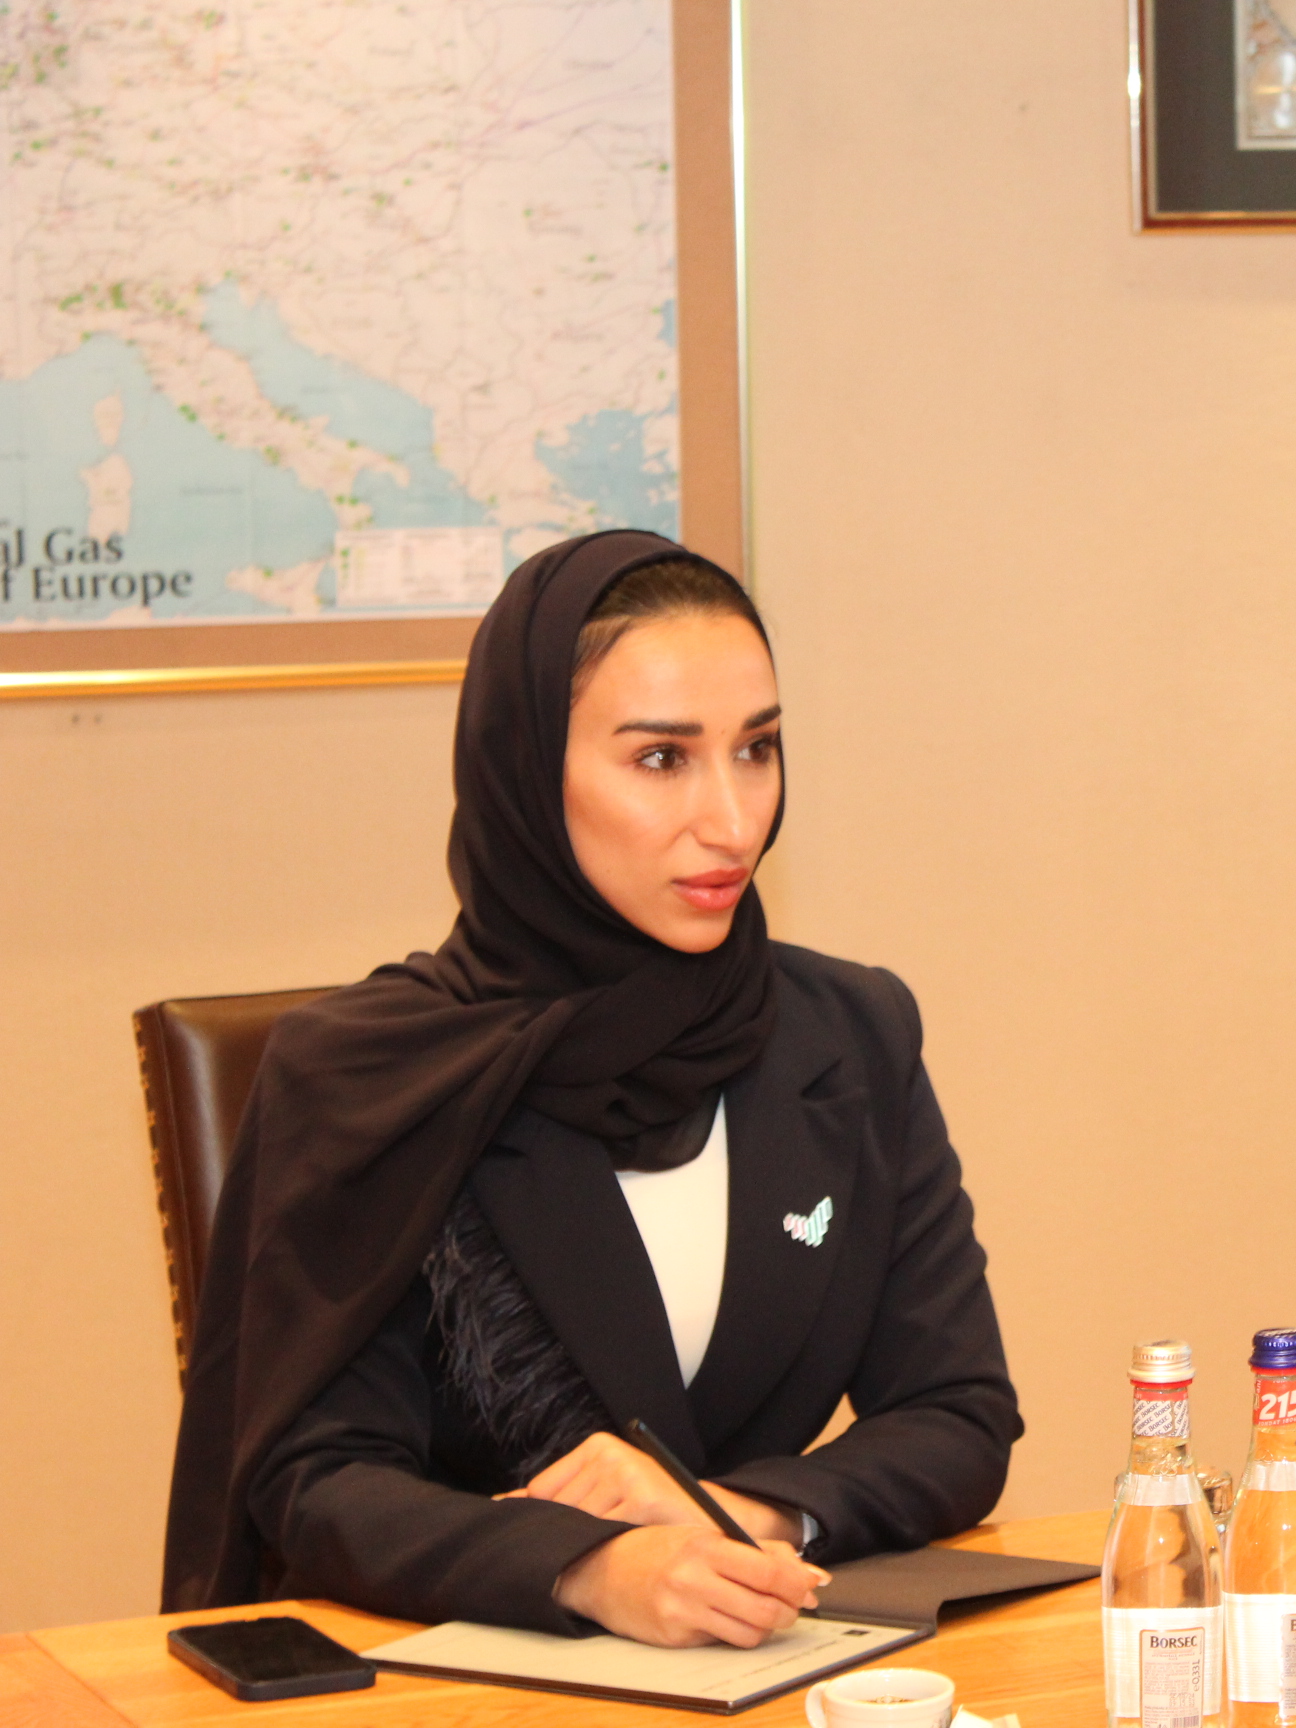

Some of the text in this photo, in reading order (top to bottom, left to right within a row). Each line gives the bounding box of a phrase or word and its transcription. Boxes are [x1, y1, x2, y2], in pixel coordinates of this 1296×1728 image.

[44, 527, 123, 565] Gas
[33, 566, 192, 607] Europe
[1150, 1635, 1197, 1648] BORSEC
